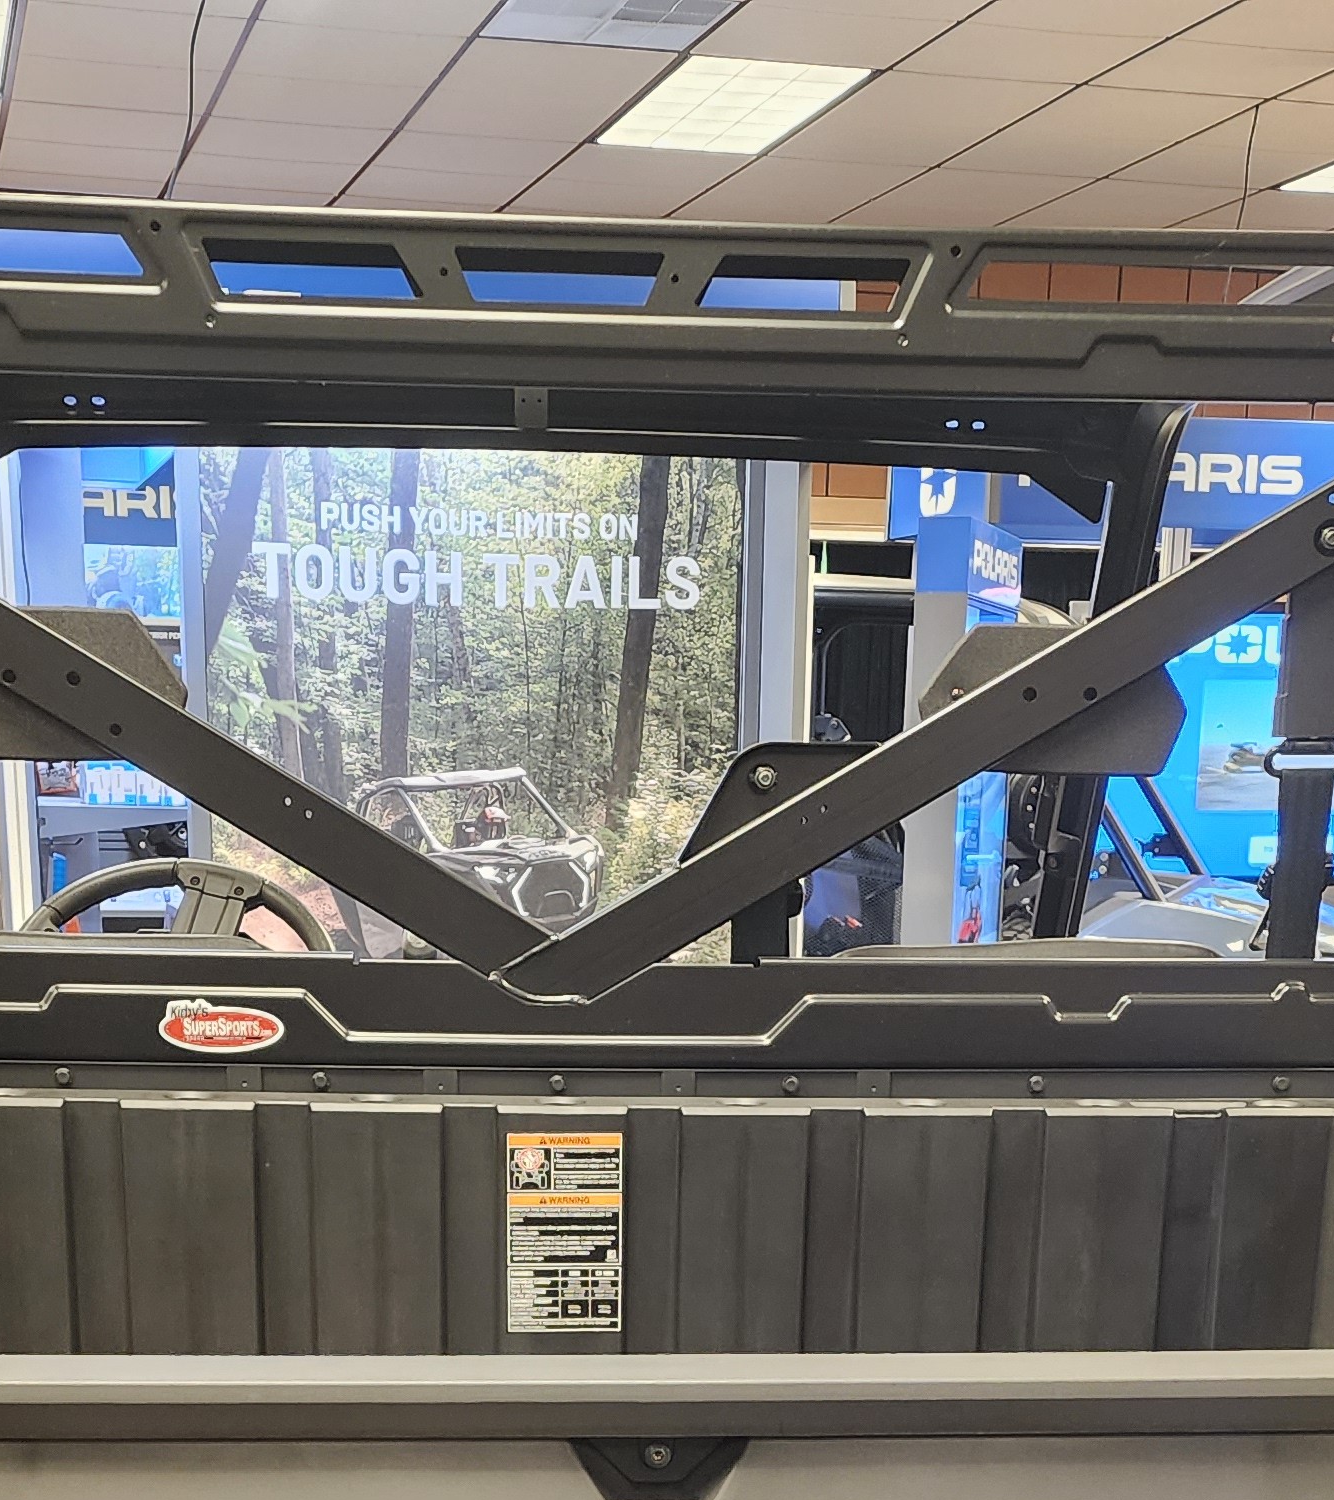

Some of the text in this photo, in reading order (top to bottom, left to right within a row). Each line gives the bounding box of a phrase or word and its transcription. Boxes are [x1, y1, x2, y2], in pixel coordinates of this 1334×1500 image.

[83, 485, 177, 519] ARI
[320, 501, 639, 542] PUSH YOUR LIMITS ON
[252, 541, 702, 611] TOUGH TRAILS
[973, 539, 1018, 590] POLARIS
[548, 1137, 591, 1145] WARNING
